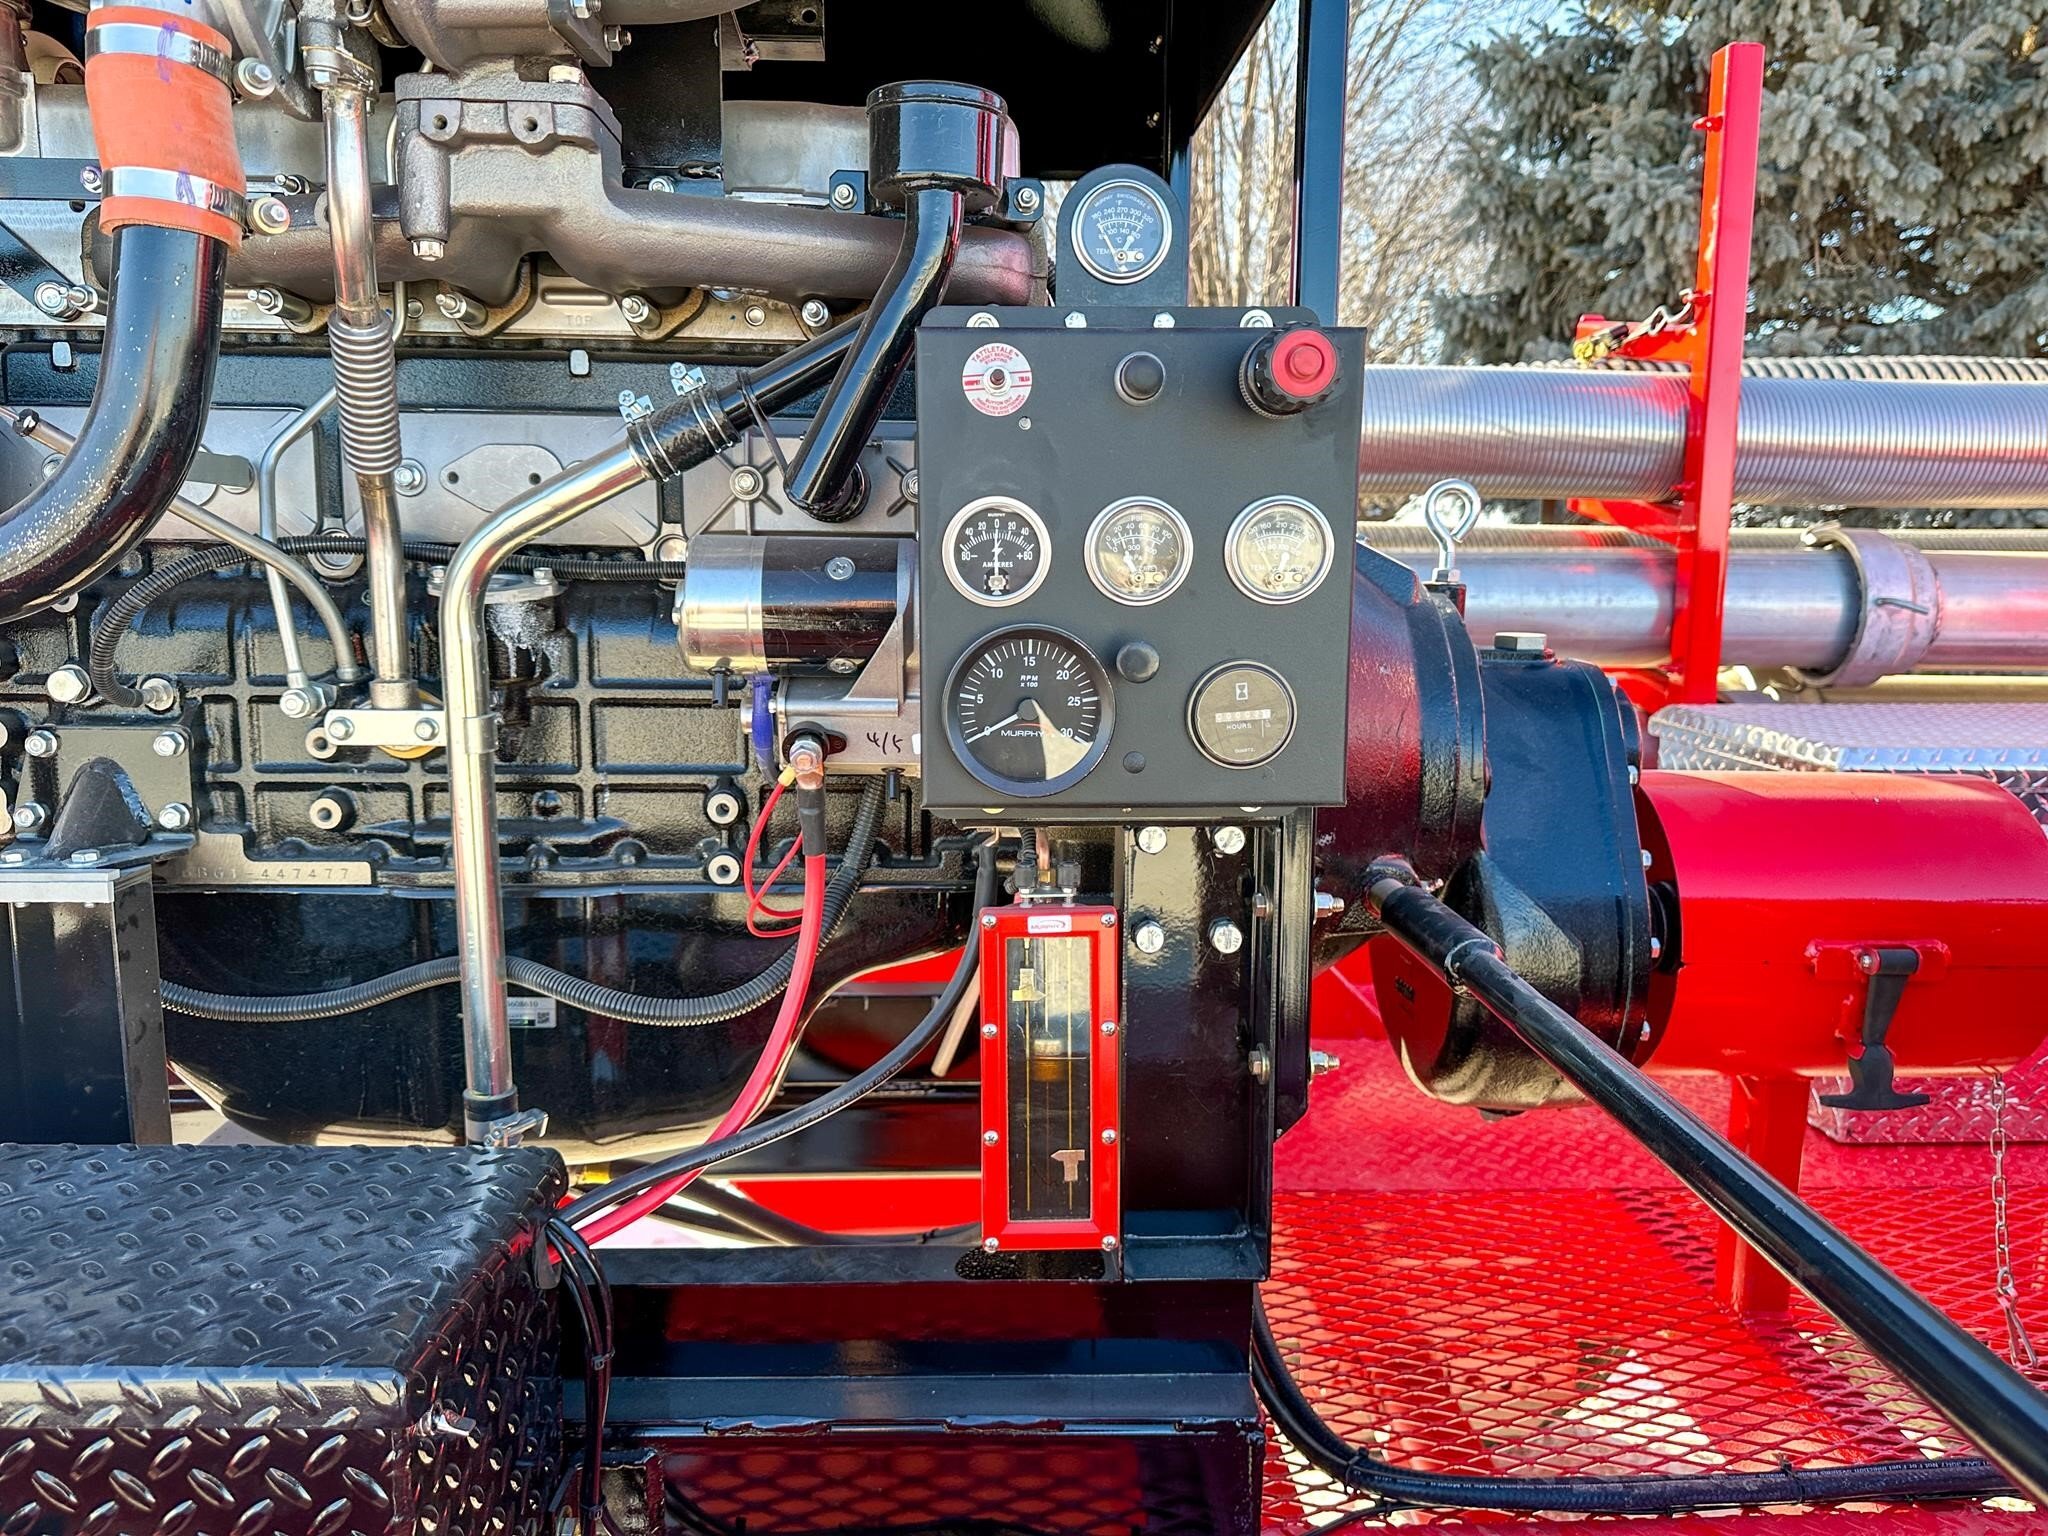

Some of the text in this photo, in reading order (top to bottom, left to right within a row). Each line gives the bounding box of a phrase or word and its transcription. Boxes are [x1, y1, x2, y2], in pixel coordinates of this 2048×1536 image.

[1130, 208, 1142, 216] 300
[566, 314, 592, 327] TOP
[972, 346, 1013, 362] TATTLETALE
[978, 522, 986, 530] 20
[995, 519, 999, 528] 0
[1008, 522, 1016, 530] 20
[1023, 656, 1036, 666] 15
[991, 668, 1003, 679] 10
[1056, 670, 1069, 680] 20
[977, 694, 983, 704] 5
[1068, 696, 1081, 706] 25
[1060, 728, 1073, 738] 30
